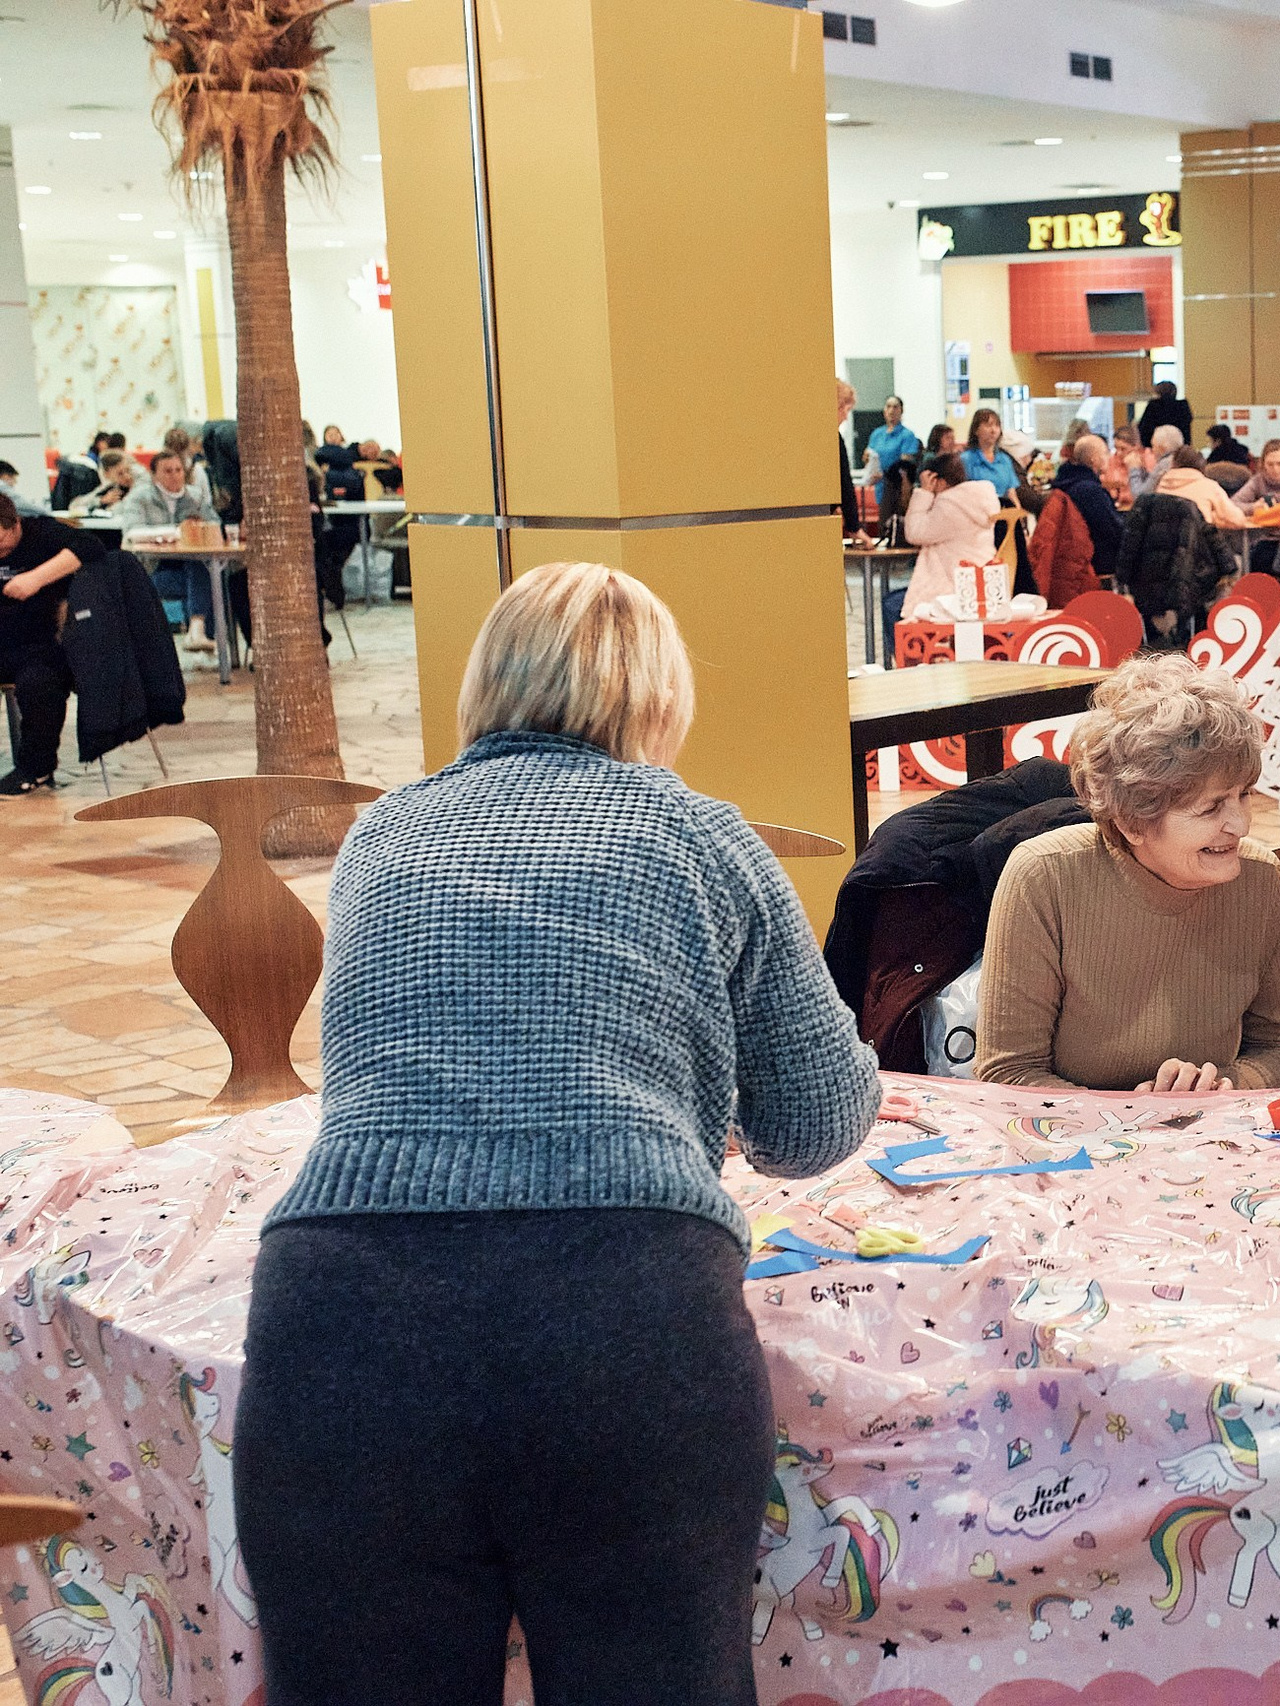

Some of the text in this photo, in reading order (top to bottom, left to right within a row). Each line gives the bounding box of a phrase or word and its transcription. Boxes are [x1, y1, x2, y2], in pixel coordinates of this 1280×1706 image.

[1027, 210, 1126, 250] FIRE
[1013, 1492, 1087, 1523] believe
[1029, 1475, 1074, 1508] just
